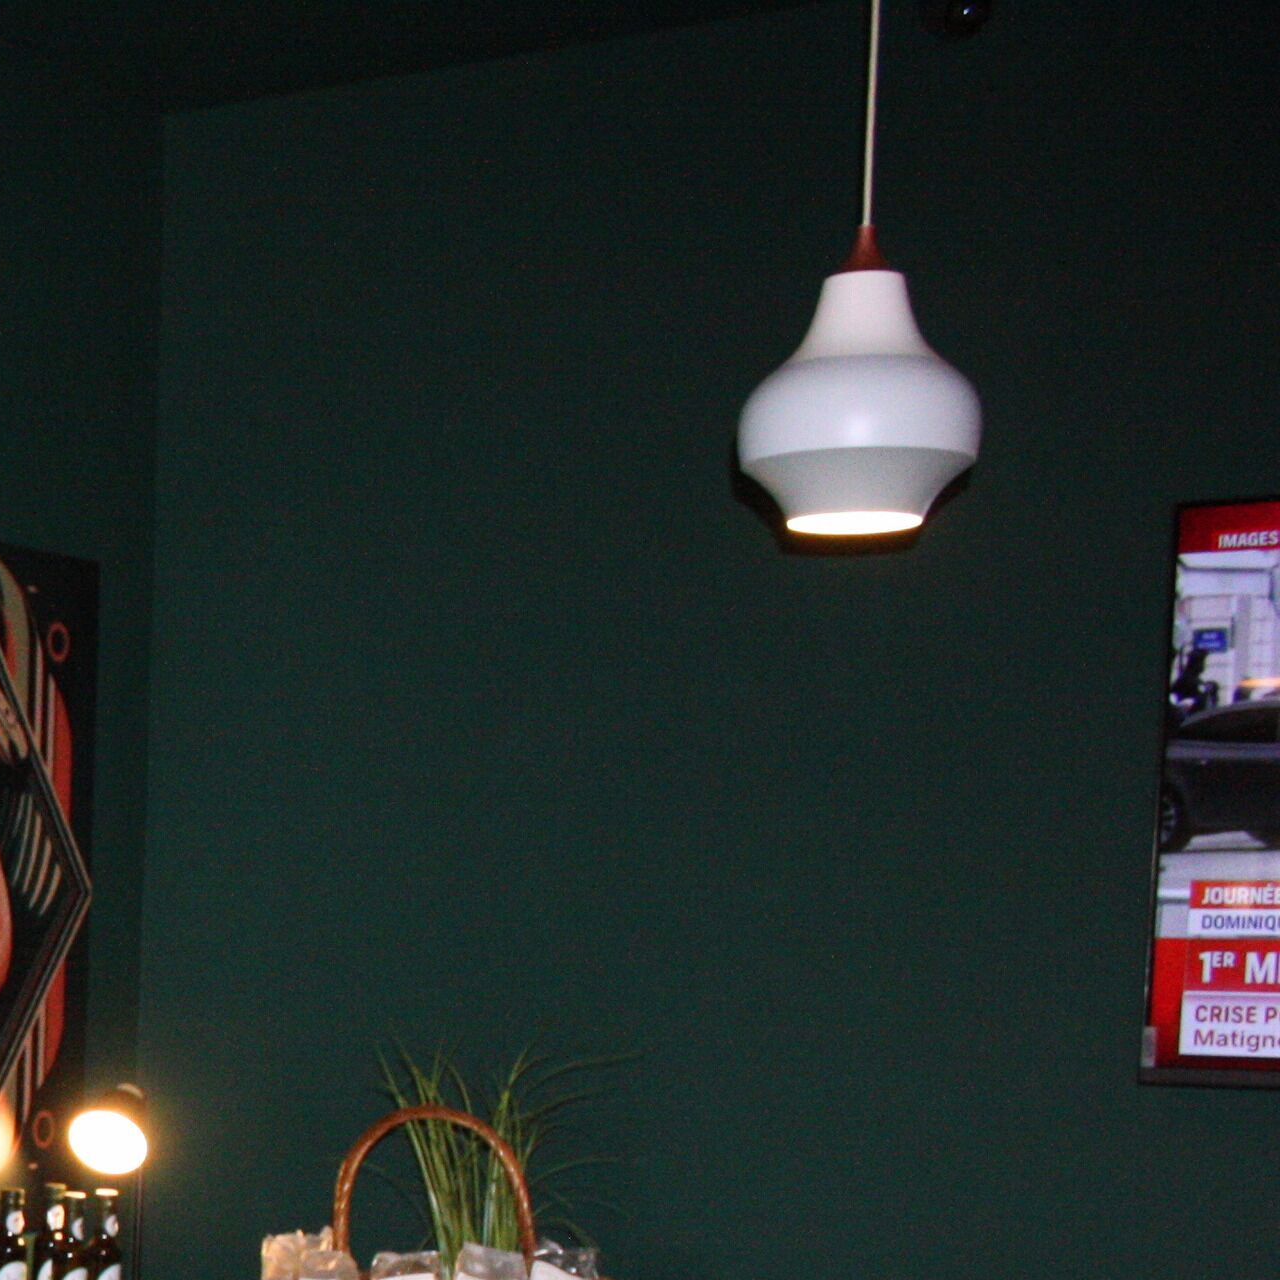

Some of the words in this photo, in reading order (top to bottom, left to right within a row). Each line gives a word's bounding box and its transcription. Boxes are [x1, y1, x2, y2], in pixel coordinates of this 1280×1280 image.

[1218, 530, 1279, 549] IMAGES
[1201, 915, 1280, 932] DOMINIQ
[1244, 951, 1280, 985] M
[1195, 1005, 1257, 1024] CRISE
[1264, 1006, 1280, 1024] P
